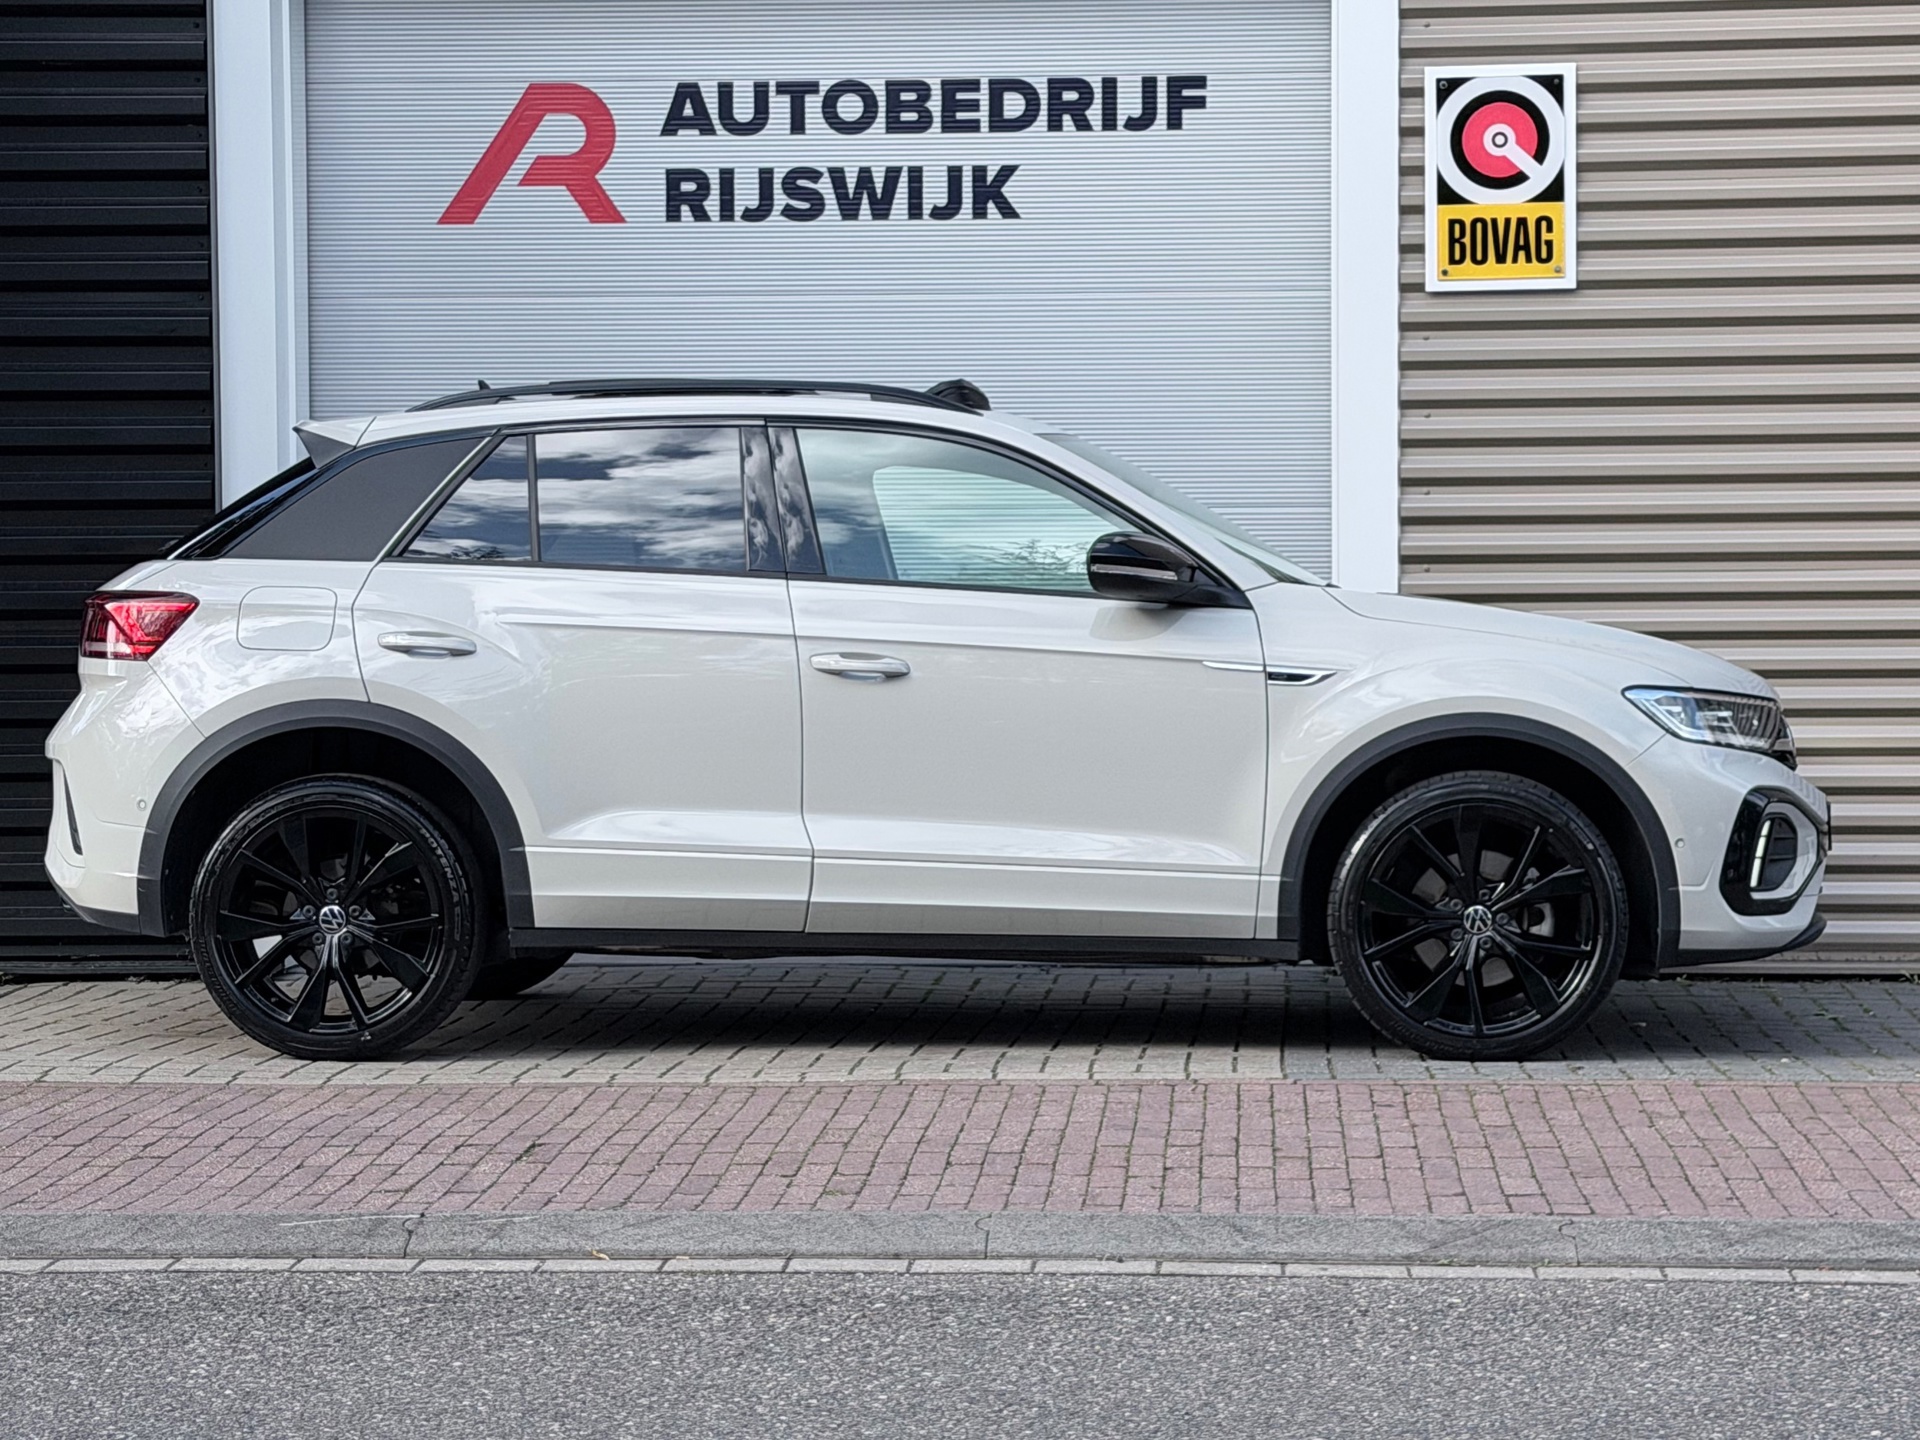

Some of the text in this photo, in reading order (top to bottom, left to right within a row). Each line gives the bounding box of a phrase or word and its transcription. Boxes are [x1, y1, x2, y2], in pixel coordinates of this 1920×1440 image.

[660, 75, 1207, 137] AUTOBEDRIJF
[665, 164, 1021, 223] RIJSWIJK
[1447, 215, 1554, 266] BOVAG
